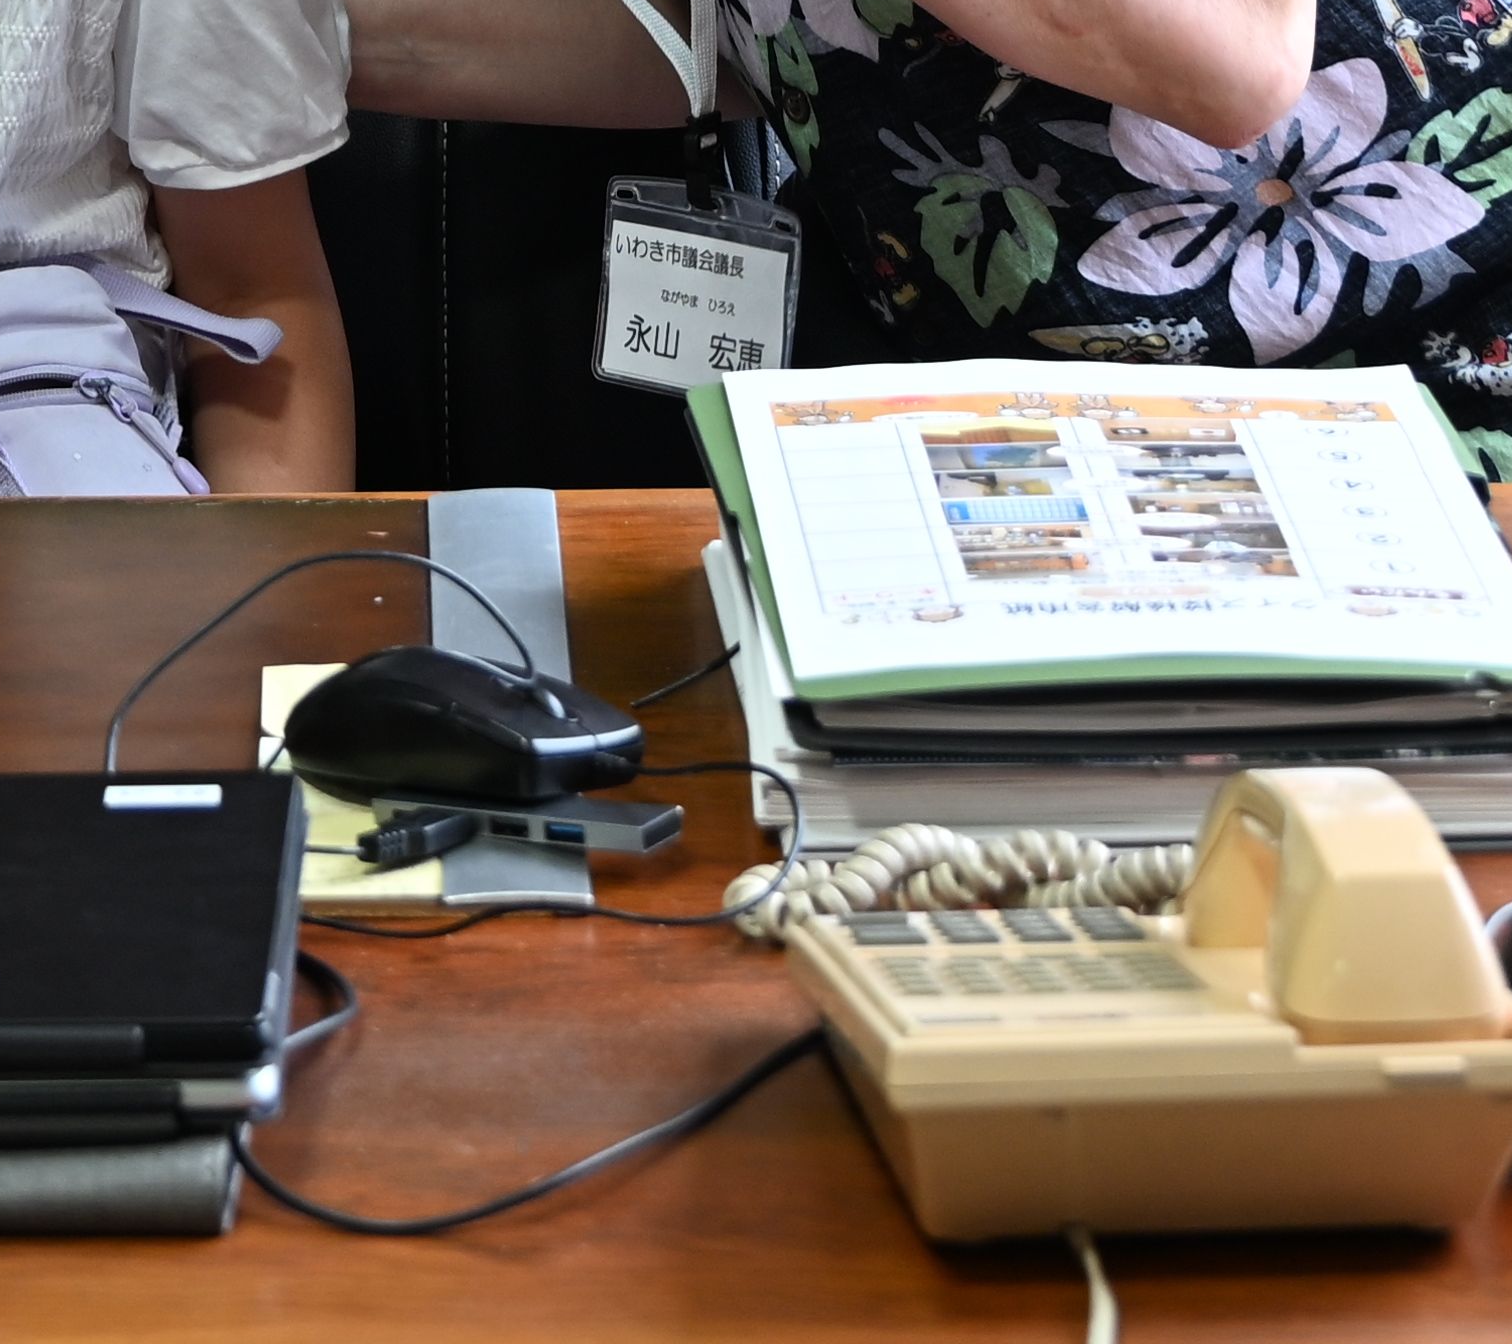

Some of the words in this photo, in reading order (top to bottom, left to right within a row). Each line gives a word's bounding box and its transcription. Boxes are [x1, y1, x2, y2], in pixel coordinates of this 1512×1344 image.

[615, 232, 745, 279] いわき市議会議長
[660, 289, 699, 308] ながやま
[708, 298, 736, 317] ひろえ
[623, 313, 680, 360] 永山
[708, 332, 765, 372] 宏恵
